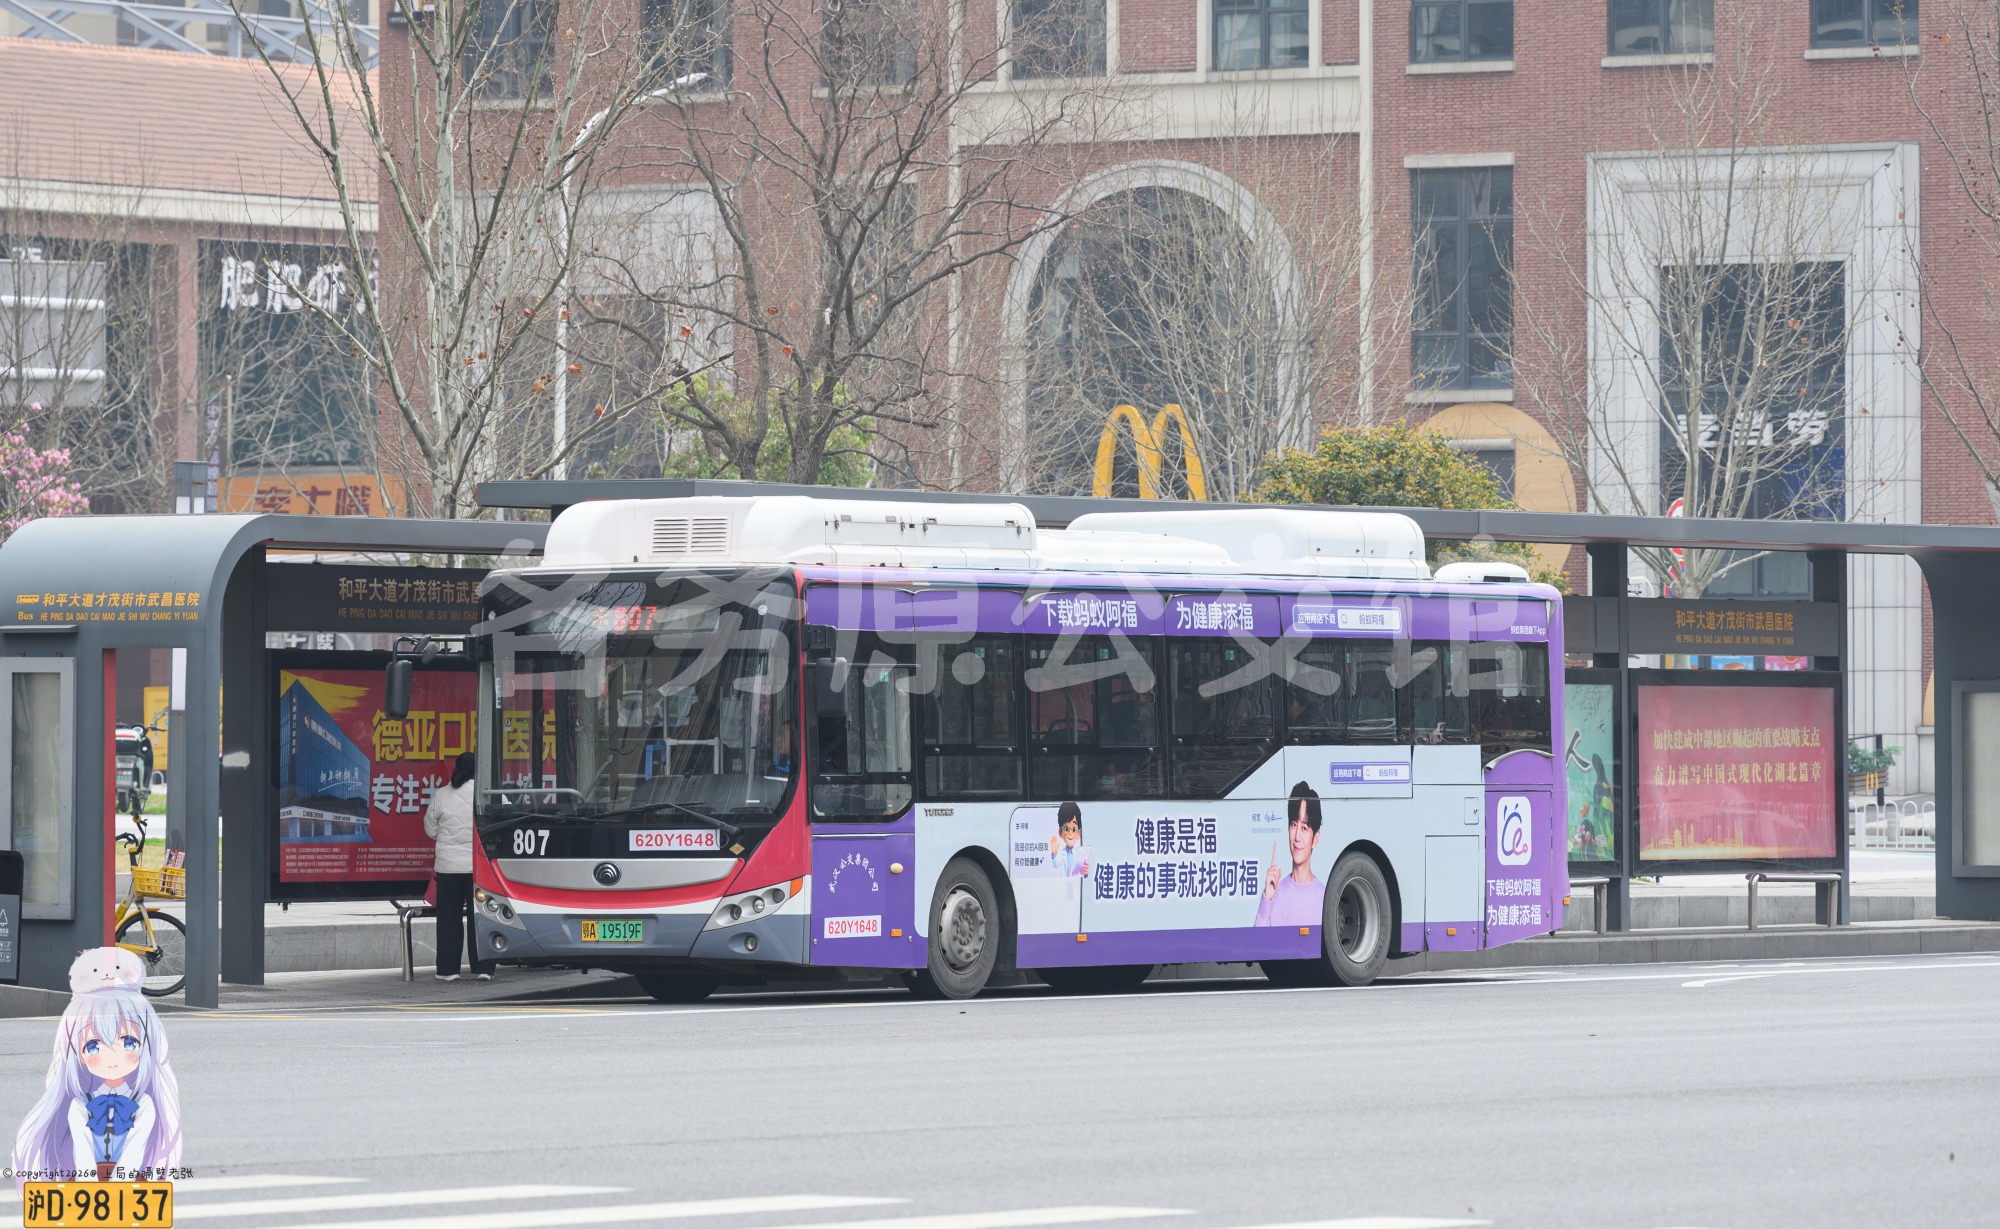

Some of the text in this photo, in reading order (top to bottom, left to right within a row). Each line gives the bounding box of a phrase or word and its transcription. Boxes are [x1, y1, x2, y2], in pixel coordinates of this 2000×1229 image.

[221, 256, 379, 315] 肥肥虾
[42, 592, 200, 608] 和平大道才茂街市武昌医院
[338, 576, 481, 604] 和平大道才茂街市武昌
[18, 611, 34, 621] Bus
[40, 612, 199, 621] HE PING DA DAO CAI MAO JIE SHI WU CHANG YI YUAN
[338, 607, 347, 618] HE
[349, 608, 365, 618] PING
[367, 608, 377, 619] DA
[379, 609, 393, 619] DAO
[395, 609, 406, 620] CAI
[408, 609, 423, 620] MAO
[437, 610, 448, 620] SHI
[450, 610, 461, 620] WU
[613, 606, 657, 631] 807
[1041, 599, 1138, 628] 下载蚂蚁阿福
[1176, 600, 1254, 631] 为健康添福
[1298, 612, 1336, 624] 应用商店下载
[1359, 614, 1385, 625] 蚂蚁阿福
[1676, 610, 1794, 632] 和平大道才茂街市武昌医院
[1653, 727, 1821, 750] 加快建成中部地区崛起的重要战略支点
[1653, 762, 1821, 786] 奋力谱写中国式现代化湖北篇章
[513, 829, 550, 855] 807
[635, 833, 714, 847] 620Y1648
[1135, 817, 1217, 855] 健康是福
[1094, 860, 1259, 900] 健康的事就找阿福
[1487, 879, 1542, 897] 下载蚂蚁阿福
[1487, 905, 1542, 926] 为健康添福
[828, 919, 878, 935] 620Y1648
